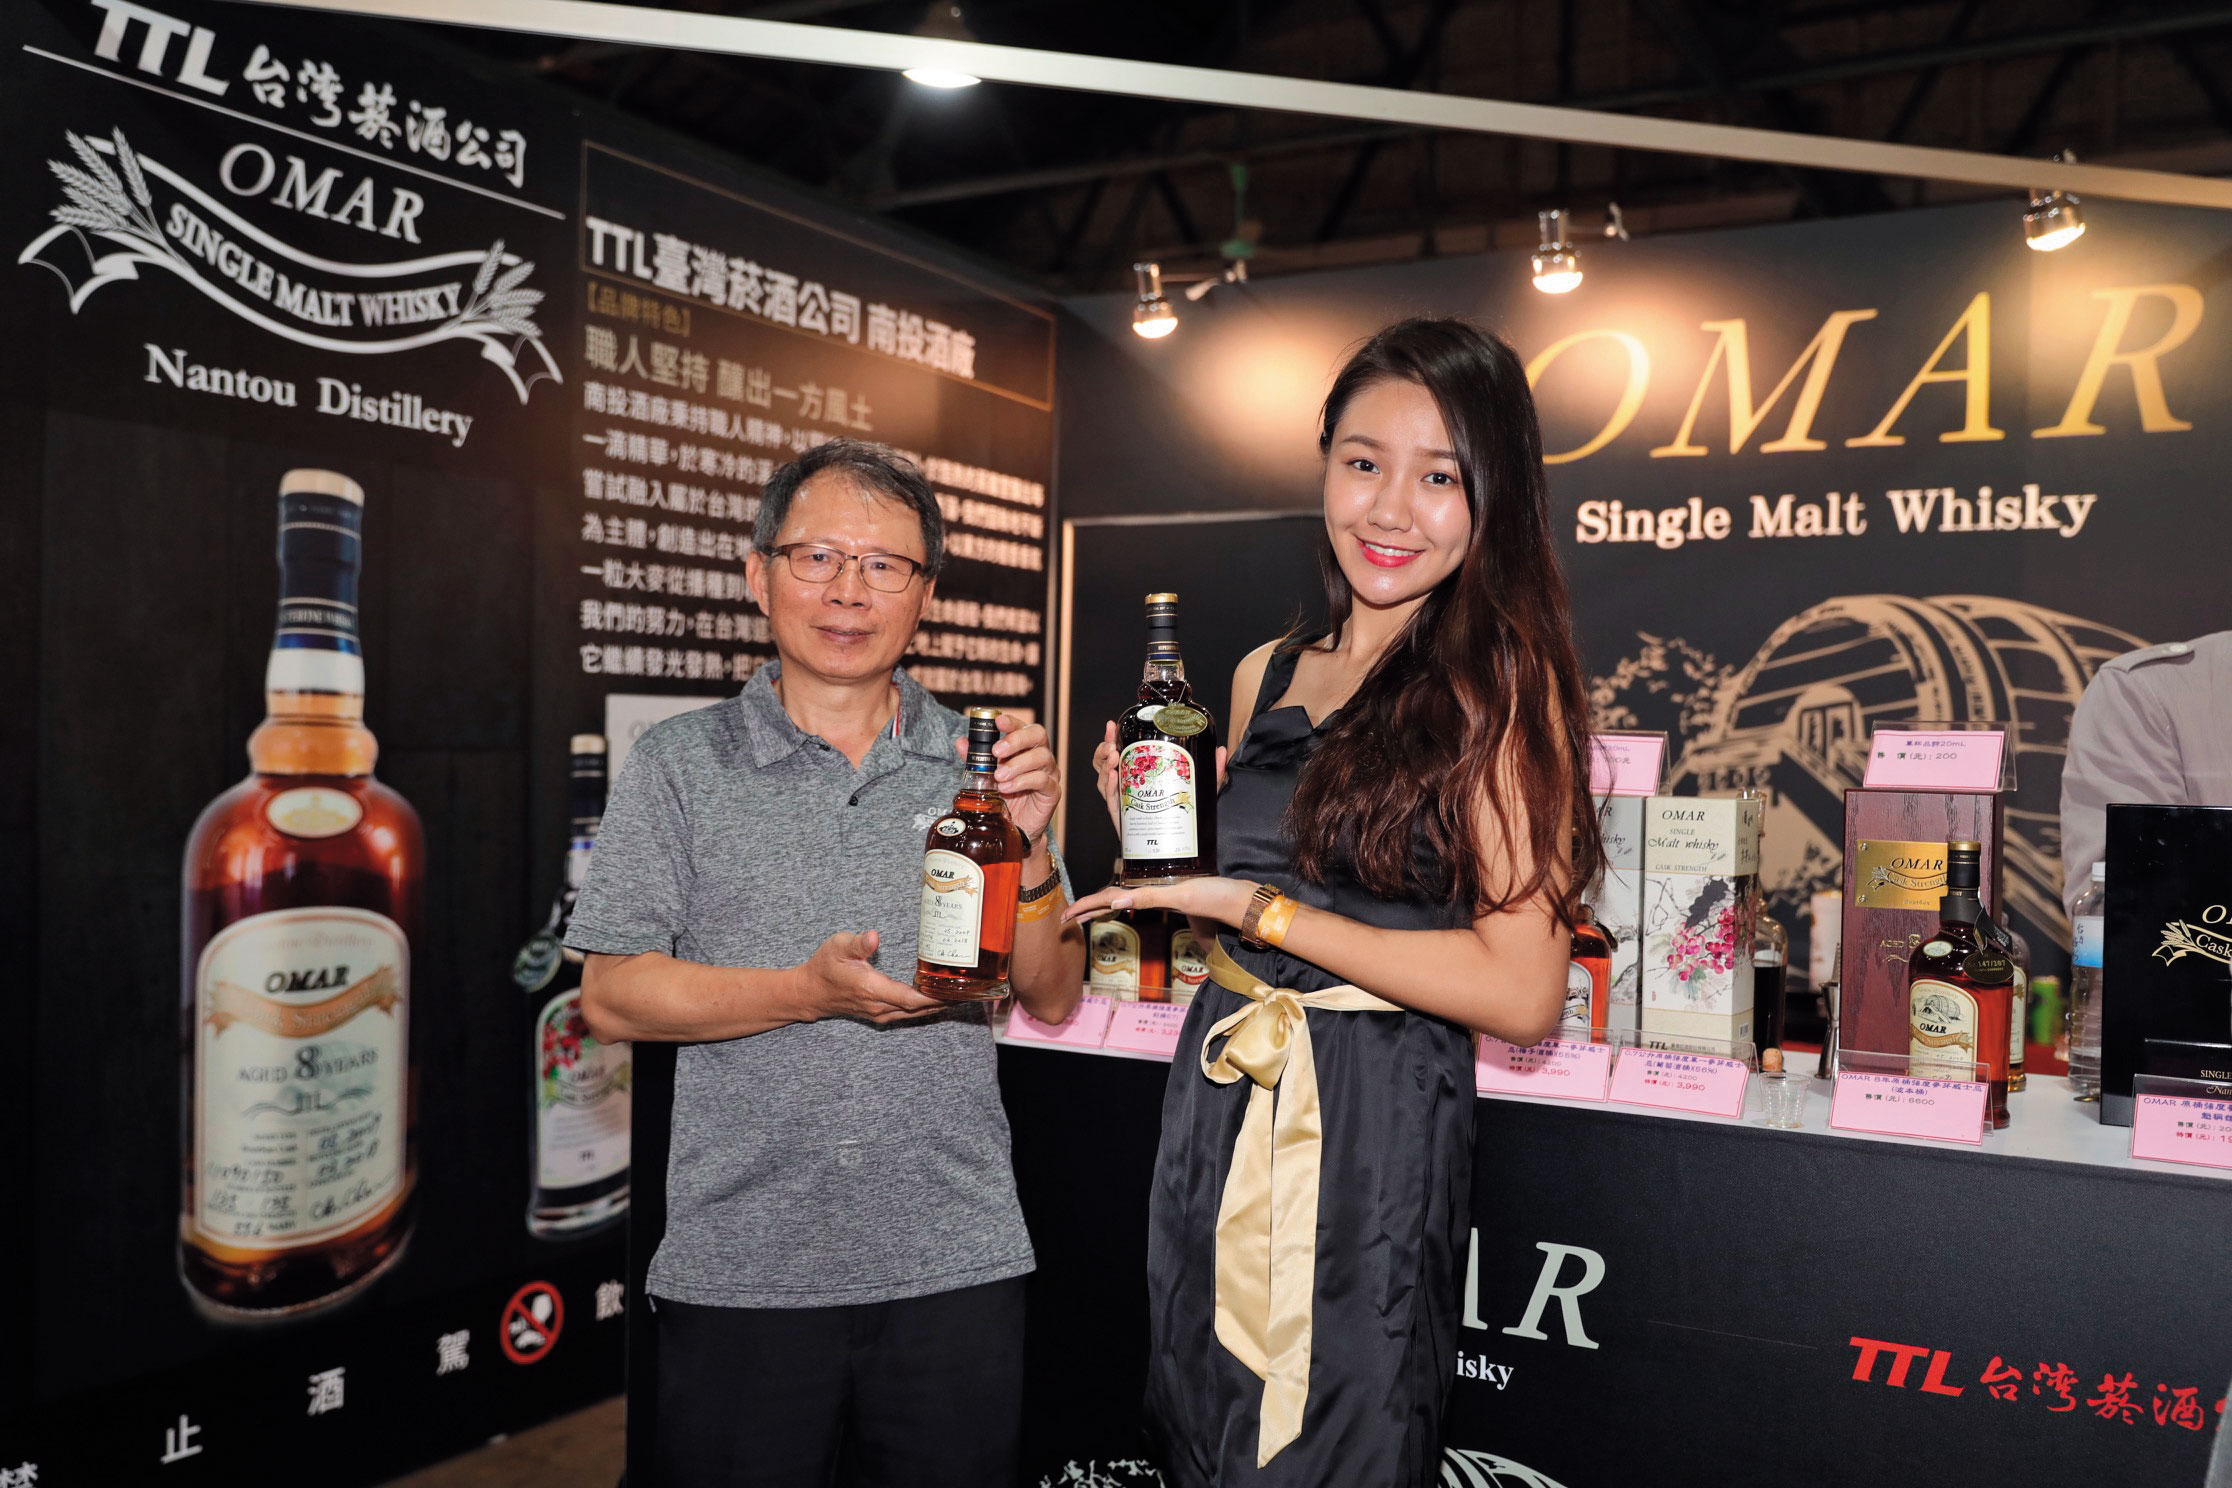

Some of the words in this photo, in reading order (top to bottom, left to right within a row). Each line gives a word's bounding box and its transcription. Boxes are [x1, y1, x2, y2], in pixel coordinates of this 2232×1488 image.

[91, 0, 230, 95] TTL
[219, 142, 425, 243] OMAR
[166, 203, 273, 301] SINGLE
[276, 274, 353, 327] MALT
[356, 282, 463, 327] WHISKY
[1526, 284, 2204, 465] OMAR
[143, 344, 298, 408] Nantou
[317, 378, 474, 447] Distillery
[1575, 498, 1731, 549] Single
[1748, 492, 1867, 538] Malt
[1887, 484, 2097, 538] Whisky
[1662, 810, 1705, 821] OMAR
[1669, 828, 1695, 836] SINGLE
[1648, 838, 1680, 848] Malt
[1685, 838, 1719, 851] whisky
[1891, 857, 1943, 870] OMAR
[931, 869, 955, 879] OMAR
[1887, 871, 1907, 885] Cask
[266, 965, 350, 993] OMAR
[1920, 1023, 1947, 1033] OMAR
[1649, 1041, 1668, 1050] TTL
[1542, 1068, 1571, 1077] 3,990
[1841, 1073, 1871, 1082] OMAR
[1677, 1082, 1705, 1091] 3,990
[2144, 1097, 2177, 1106] OMAR
[1455, 1351, 1514, 1391] isky
[1849, 1336, 1966, 1397] TTL
